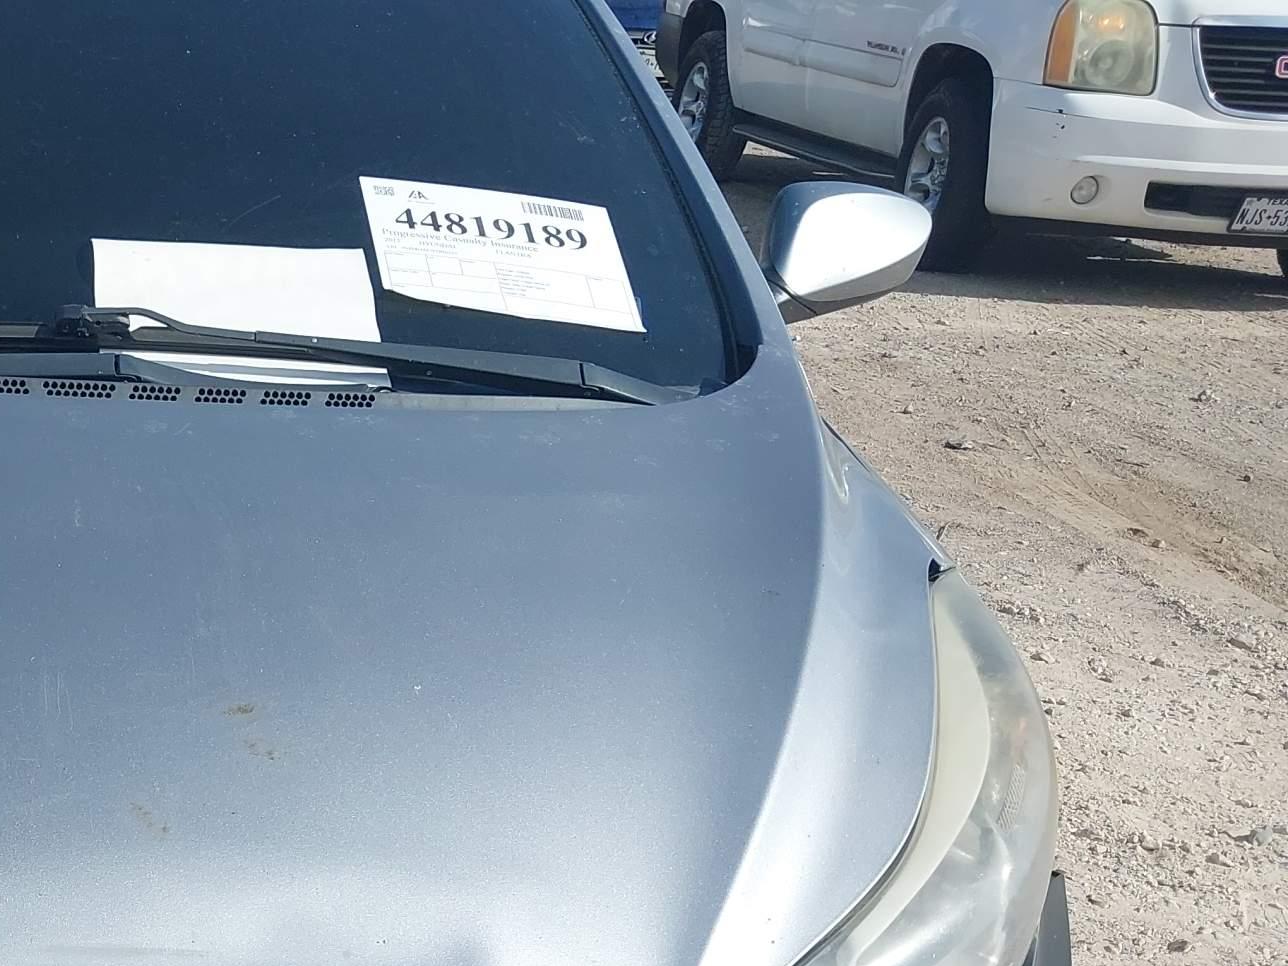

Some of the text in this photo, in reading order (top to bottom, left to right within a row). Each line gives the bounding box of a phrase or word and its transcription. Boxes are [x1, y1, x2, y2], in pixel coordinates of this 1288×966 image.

[382, 228, 539, 252] Progressive Casualty Insurance
[395, 208, 588, 250] 44819189
